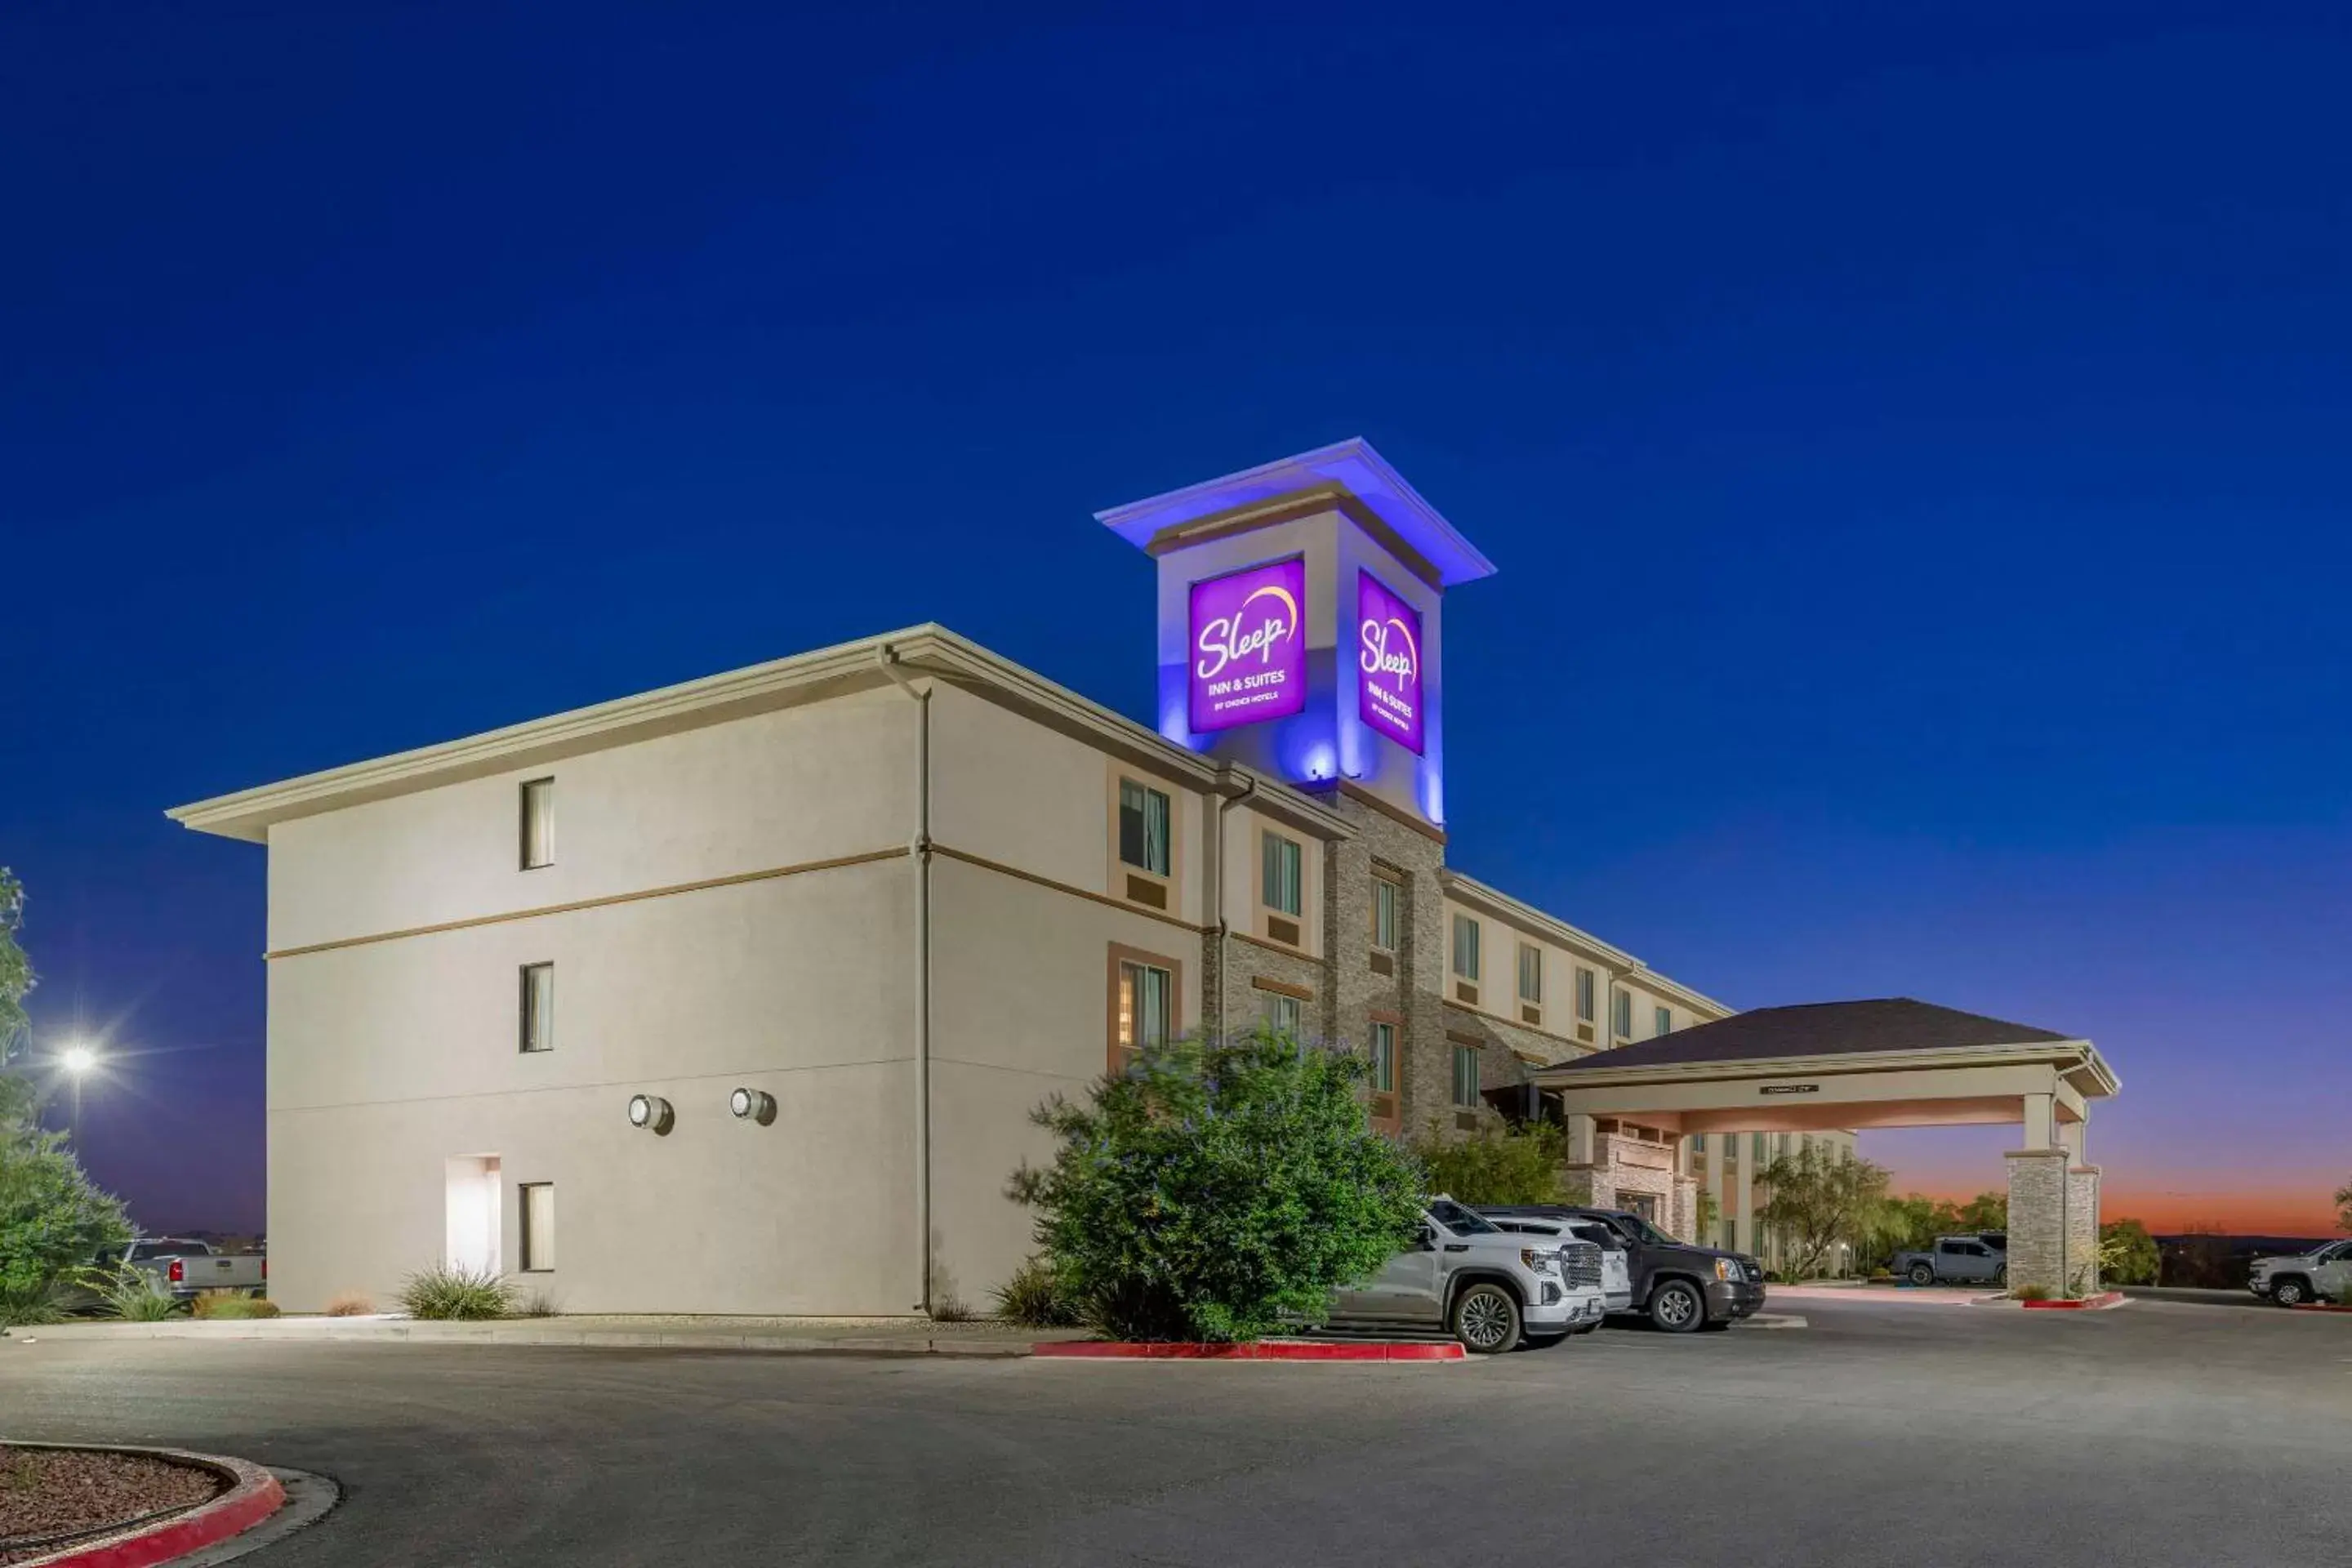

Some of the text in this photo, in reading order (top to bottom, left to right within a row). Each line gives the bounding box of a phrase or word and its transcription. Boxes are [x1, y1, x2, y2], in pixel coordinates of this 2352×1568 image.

[1197, 612, 1287, 678] Sleep
[1361, 619, 1412, 693] Sleep
[1209, 670, 1285, 696] INN & SUITES
[1389, 695, 1412, 718] SUITES
